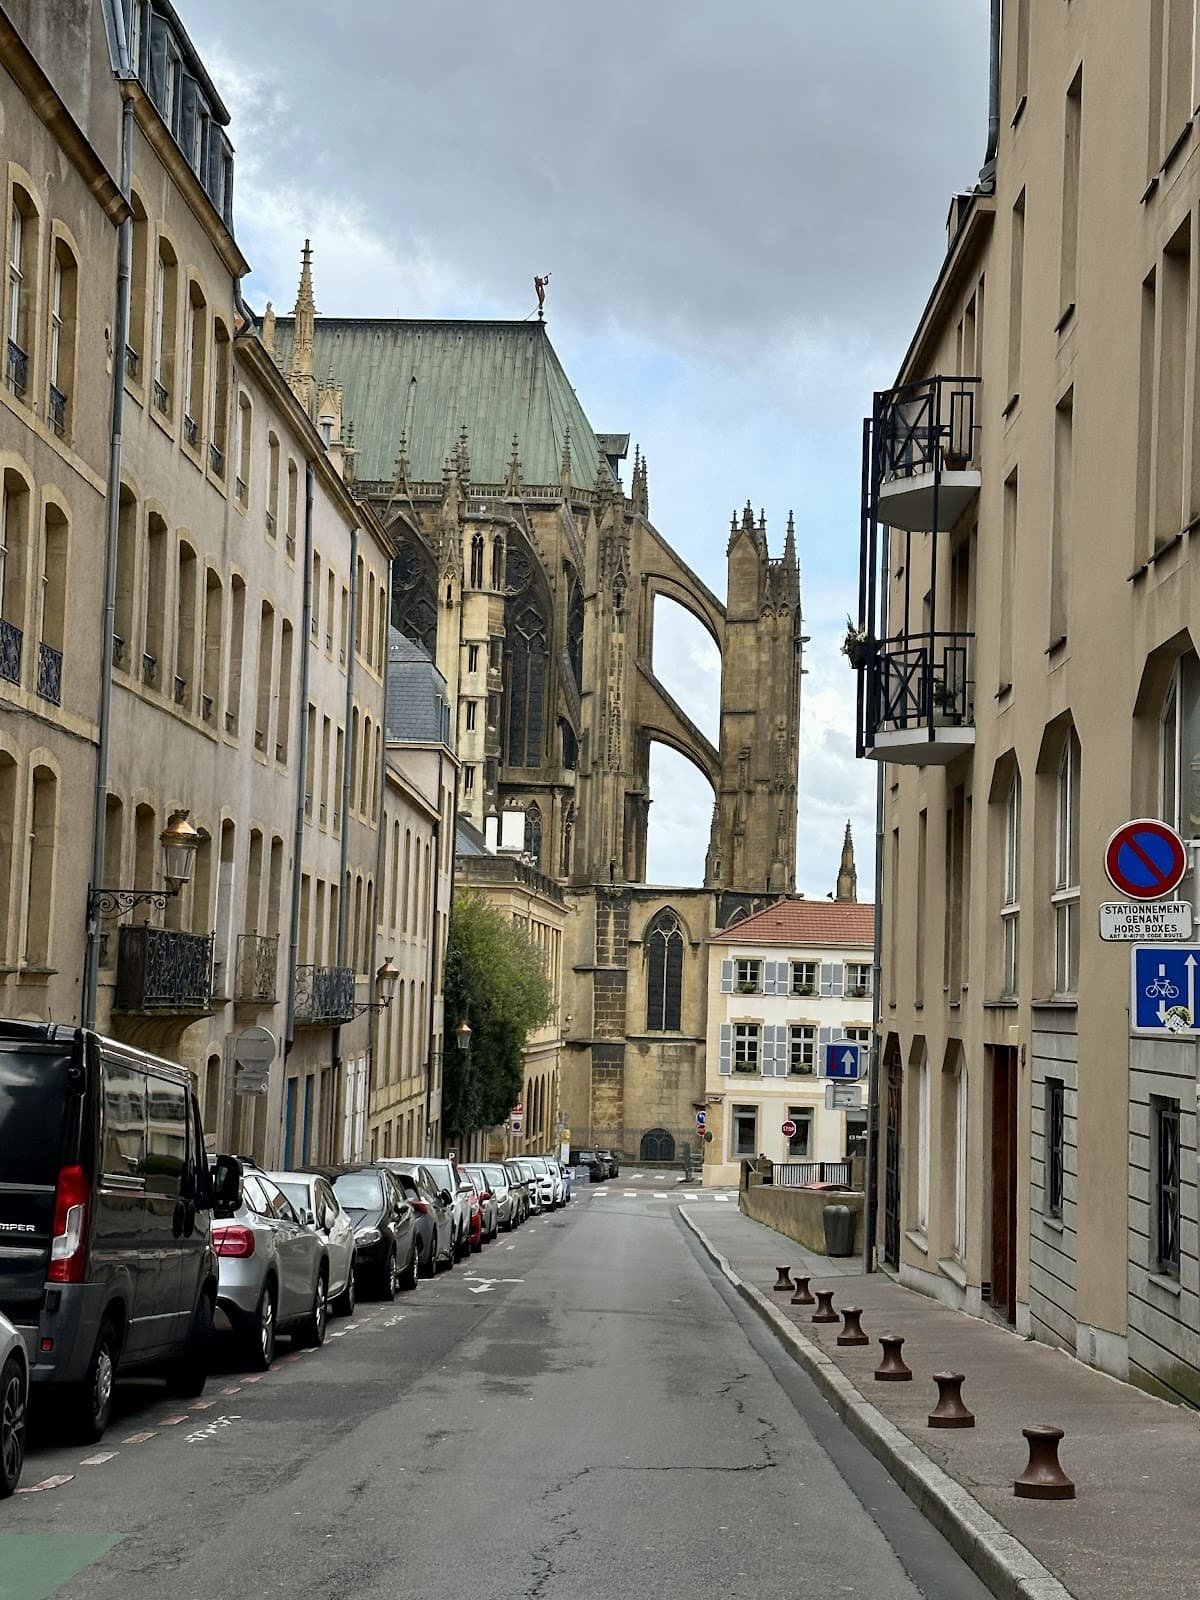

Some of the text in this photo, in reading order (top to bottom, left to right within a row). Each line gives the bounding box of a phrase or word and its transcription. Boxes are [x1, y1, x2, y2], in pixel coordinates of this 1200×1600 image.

[1105, 905, 1186, 915] STATIONNEMENT
[1126, 915, 1165, 923] GENANT
[1114, 924, 1177, 933] HORS BOXES
